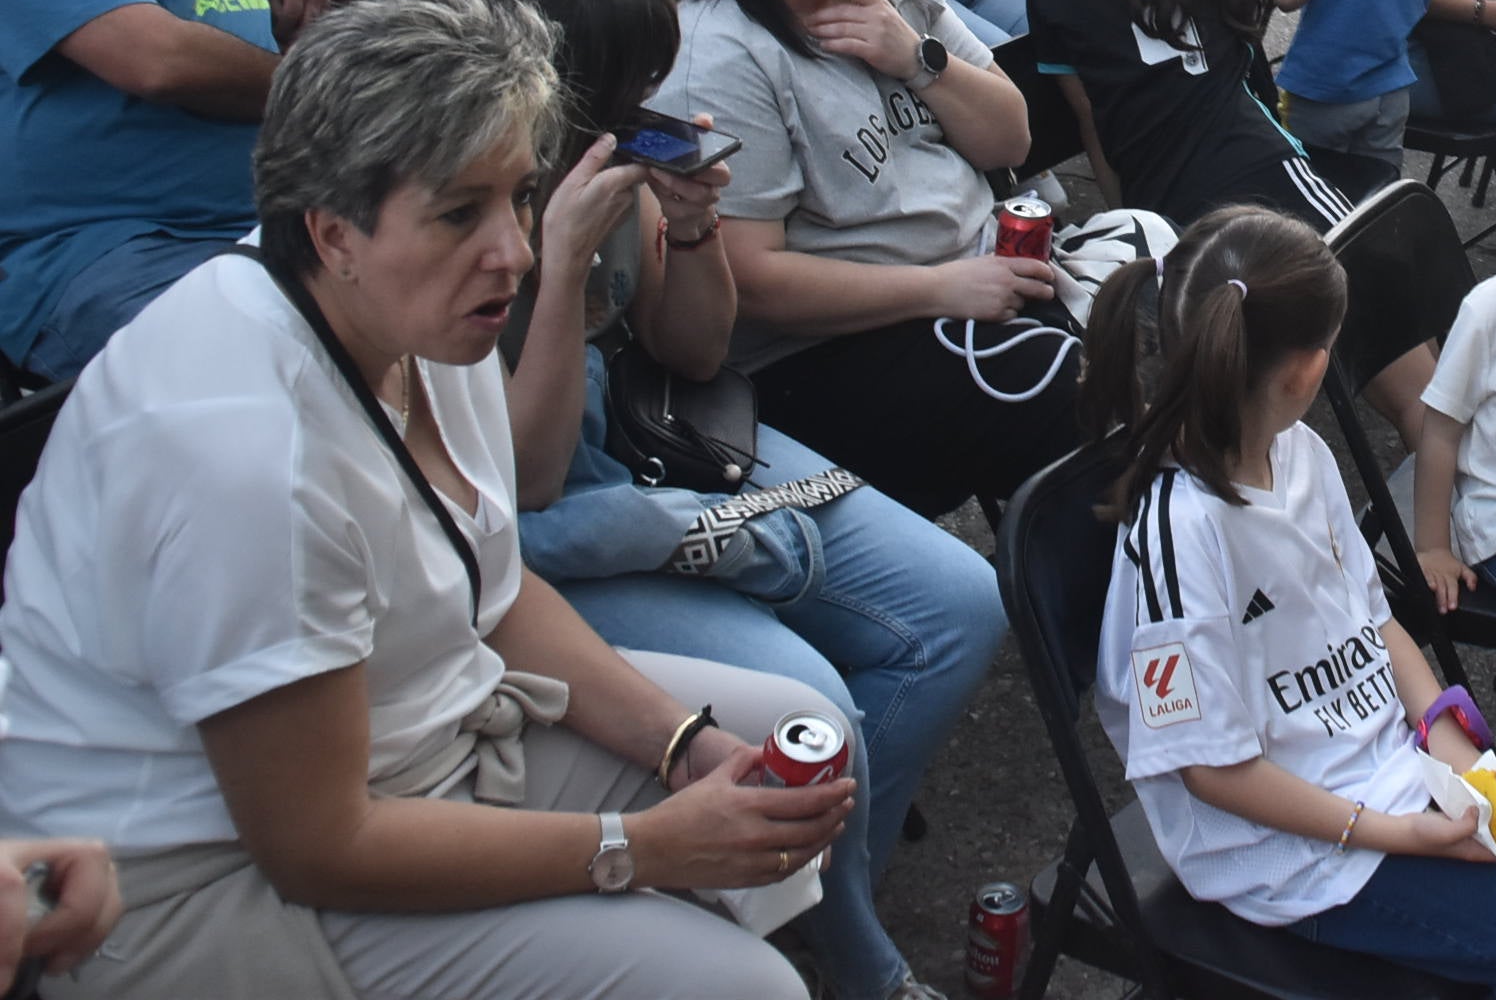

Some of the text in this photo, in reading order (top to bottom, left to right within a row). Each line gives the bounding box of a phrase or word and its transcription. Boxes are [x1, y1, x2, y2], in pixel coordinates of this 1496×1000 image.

[1148, 696, 1194, 719] LALIGA
[1313, 661, 1397, 739] FLY BETT
